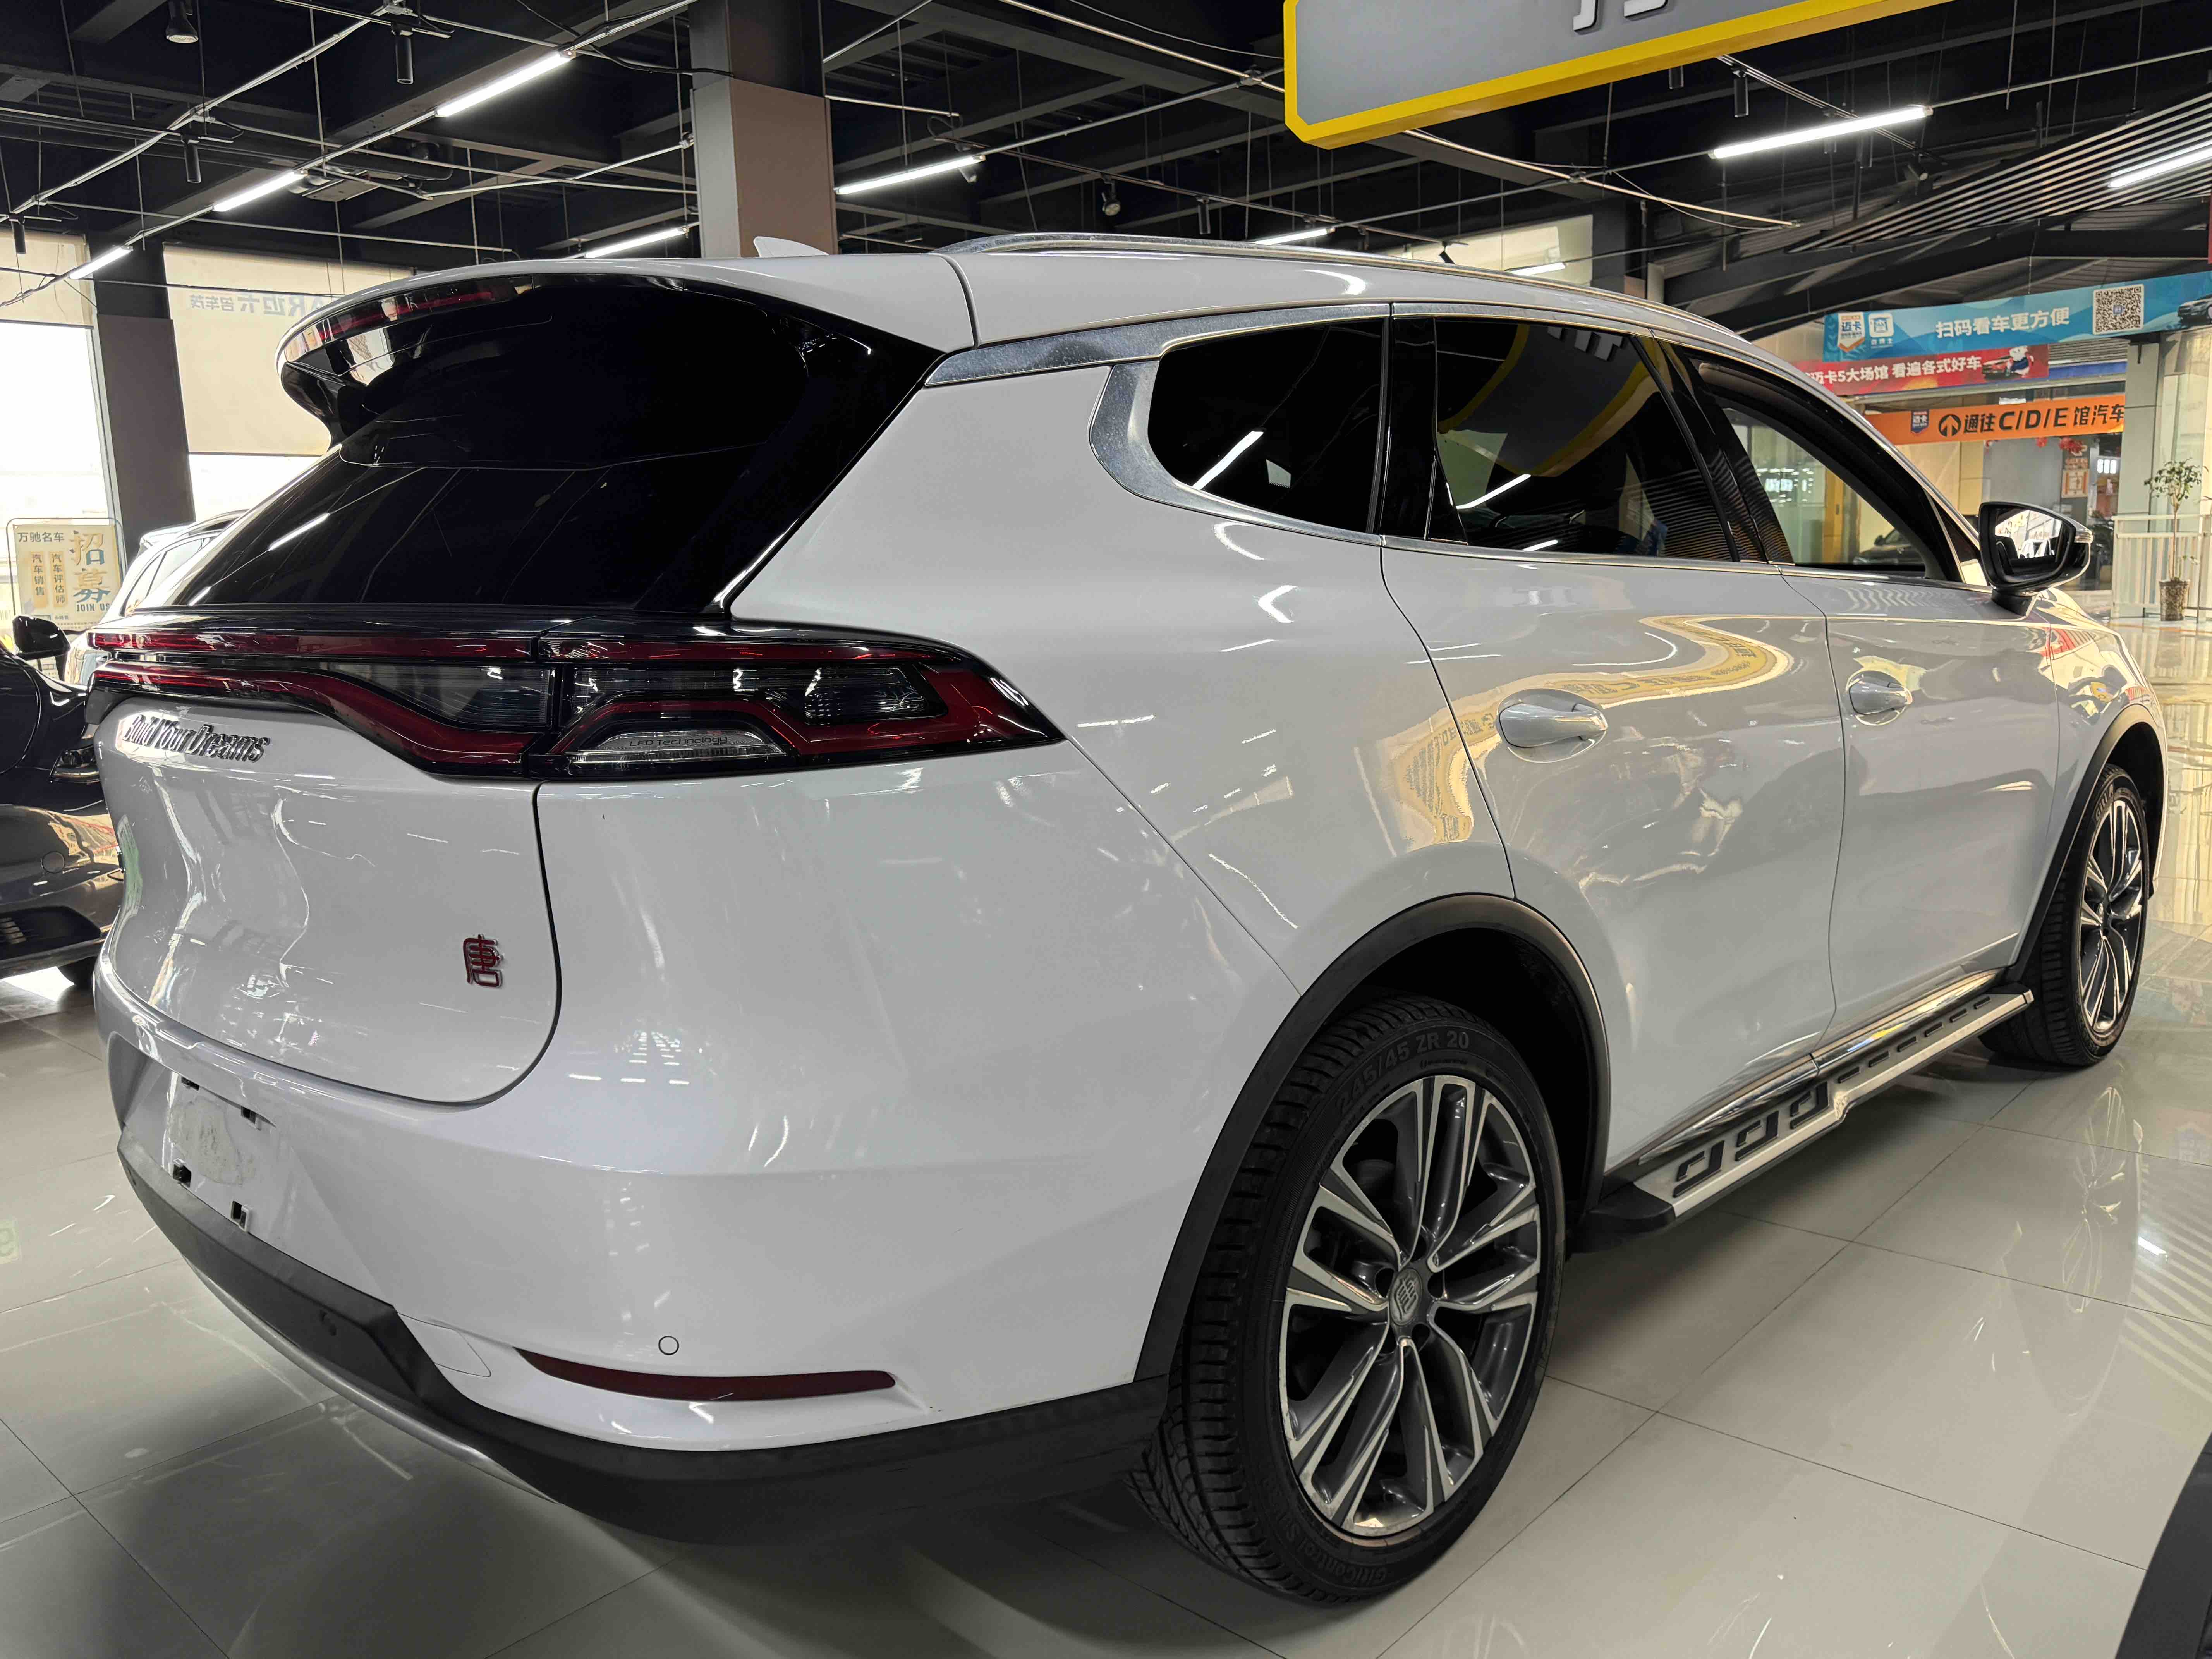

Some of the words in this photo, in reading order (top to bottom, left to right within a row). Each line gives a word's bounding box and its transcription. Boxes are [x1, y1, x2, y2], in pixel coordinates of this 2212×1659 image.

[1841, 321, 1862, 331] 迈卡
[1936, 307, 2070, 338] 扫码看车更方便
[1805, 365, 1889, 385] 迈卡5大场馆
[1892, 355, 1982, 378] 看遍各式好车
[17, 532, 65, 543] 万驰名车
[32, 553, 45, 596] 汽车销售
[52, 553, 65, 604] 汽车评估师
[76, 604, 95, 612] JOIN
[122, 714, 160, 746] Build
[156, 718, 197, 753] Your
[185, 724, 271, 762] Dreams
[657, 737, 728, 745] Technology
[463, 933, 504, 988] 唐
[1416, 1032, 1440, 1054] ZR
[1446, 1030, 1470, 1049] 20
